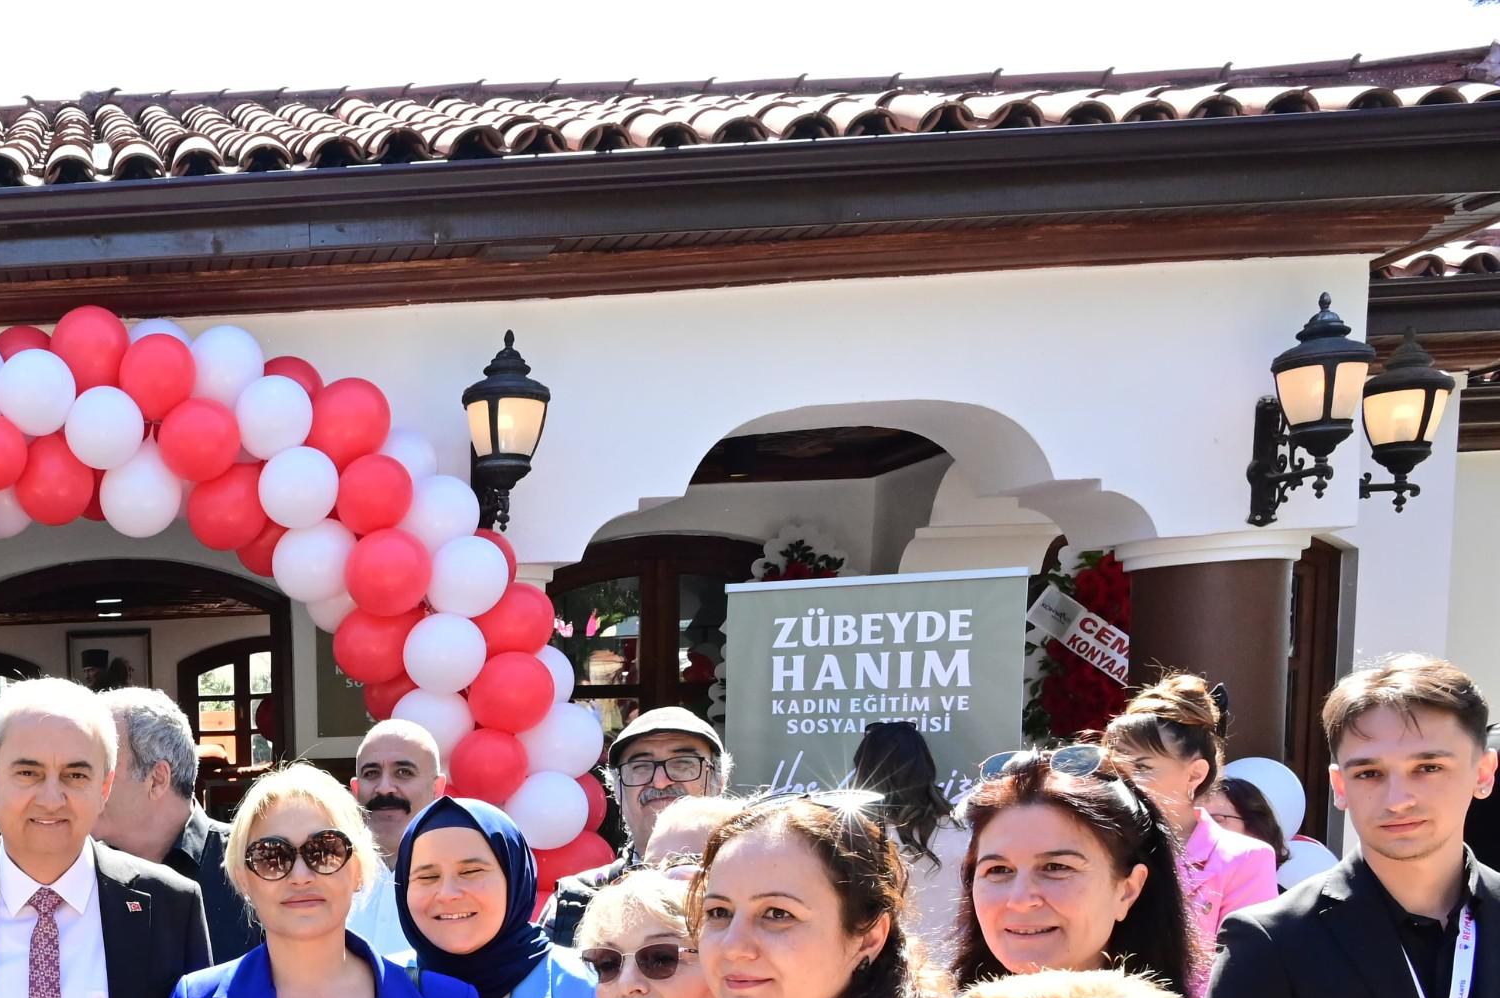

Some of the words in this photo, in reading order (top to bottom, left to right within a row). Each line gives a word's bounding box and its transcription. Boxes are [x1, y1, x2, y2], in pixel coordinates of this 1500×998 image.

[773, 608, 973, 649] ZÜBEYDE
[772, 649, 973, 692] HANIM
[772, 697, 841, 715] KADIN
[849, 692, 930, 713] EĞİTİM
[940, 694, 970, 711] VE
